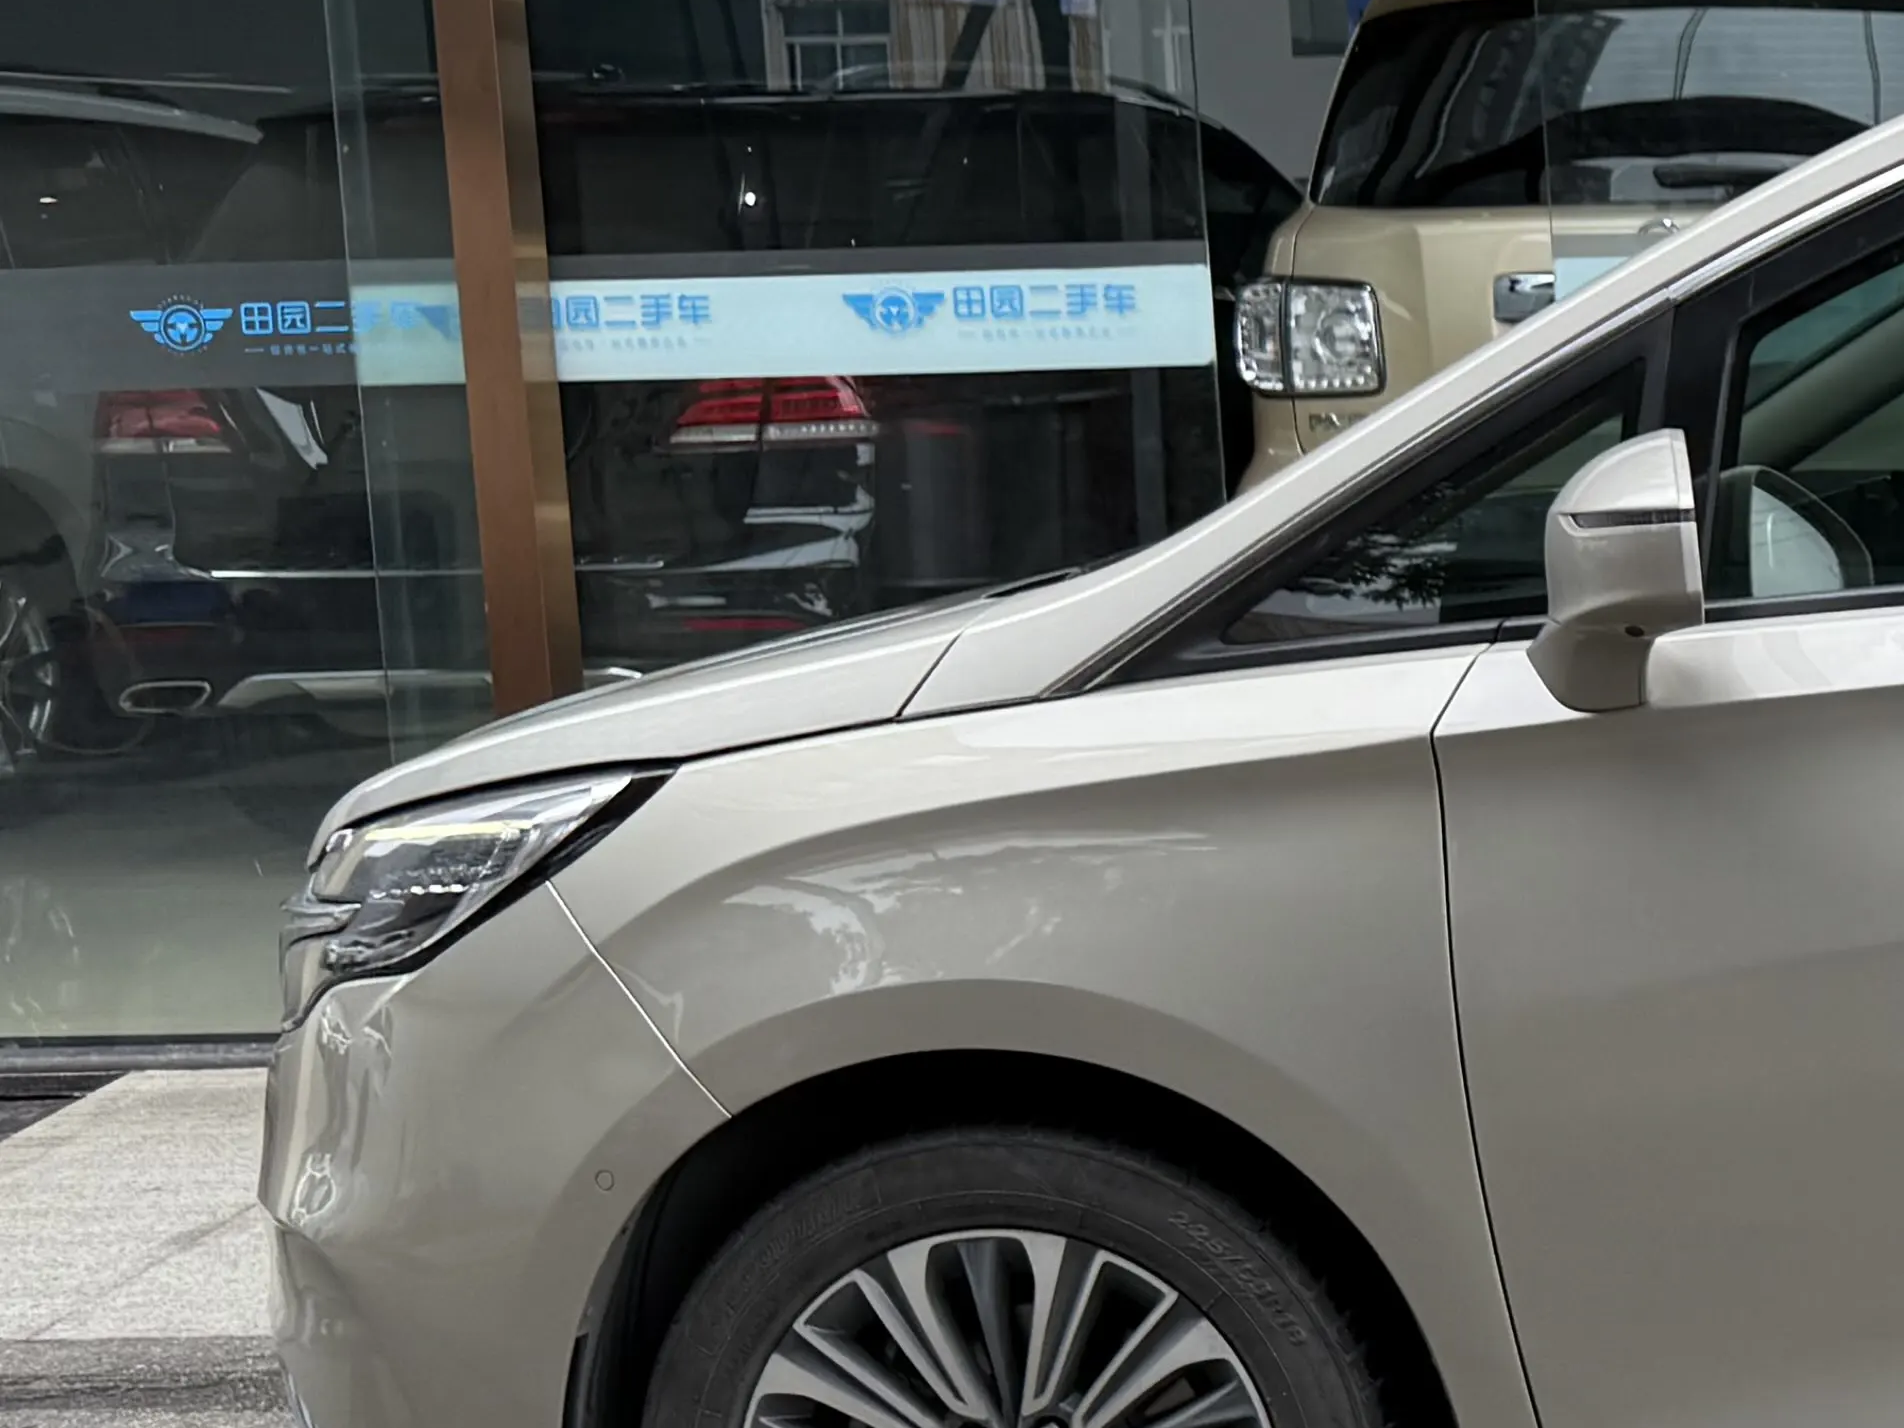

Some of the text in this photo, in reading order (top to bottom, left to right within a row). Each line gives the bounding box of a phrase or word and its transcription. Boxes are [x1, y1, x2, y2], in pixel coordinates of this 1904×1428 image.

[551, 294, 711, 330] 园二手车
[953, 284, 1137, 319] 田园二手车
